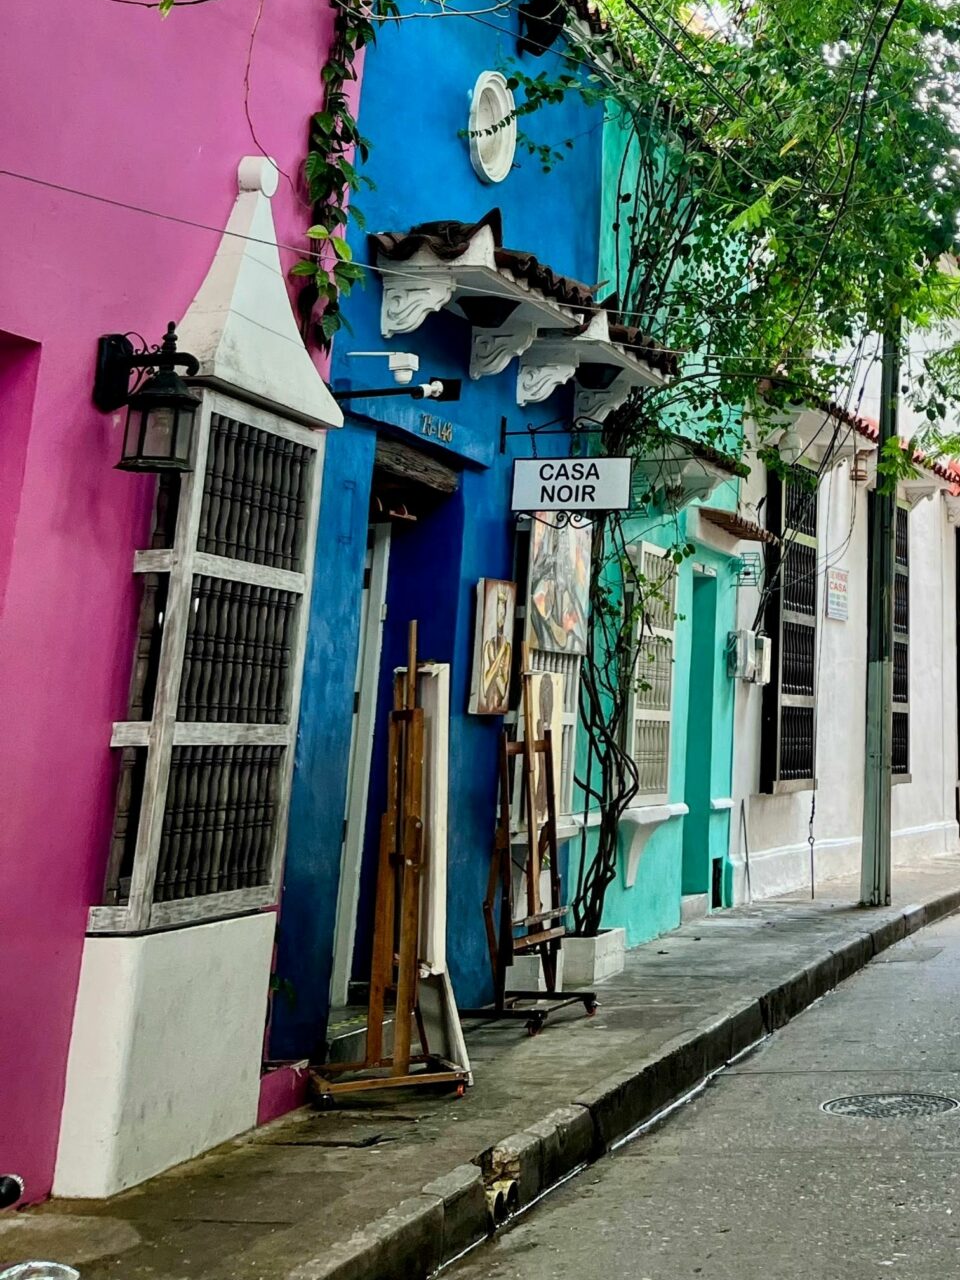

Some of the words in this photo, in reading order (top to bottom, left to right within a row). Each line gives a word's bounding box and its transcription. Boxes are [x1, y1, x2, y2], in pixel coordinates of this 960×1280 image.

[539, 463, 600, 481] CASA
[540, 484, 596, 503] NOIR
[829, 581, 847, 593] CASA
